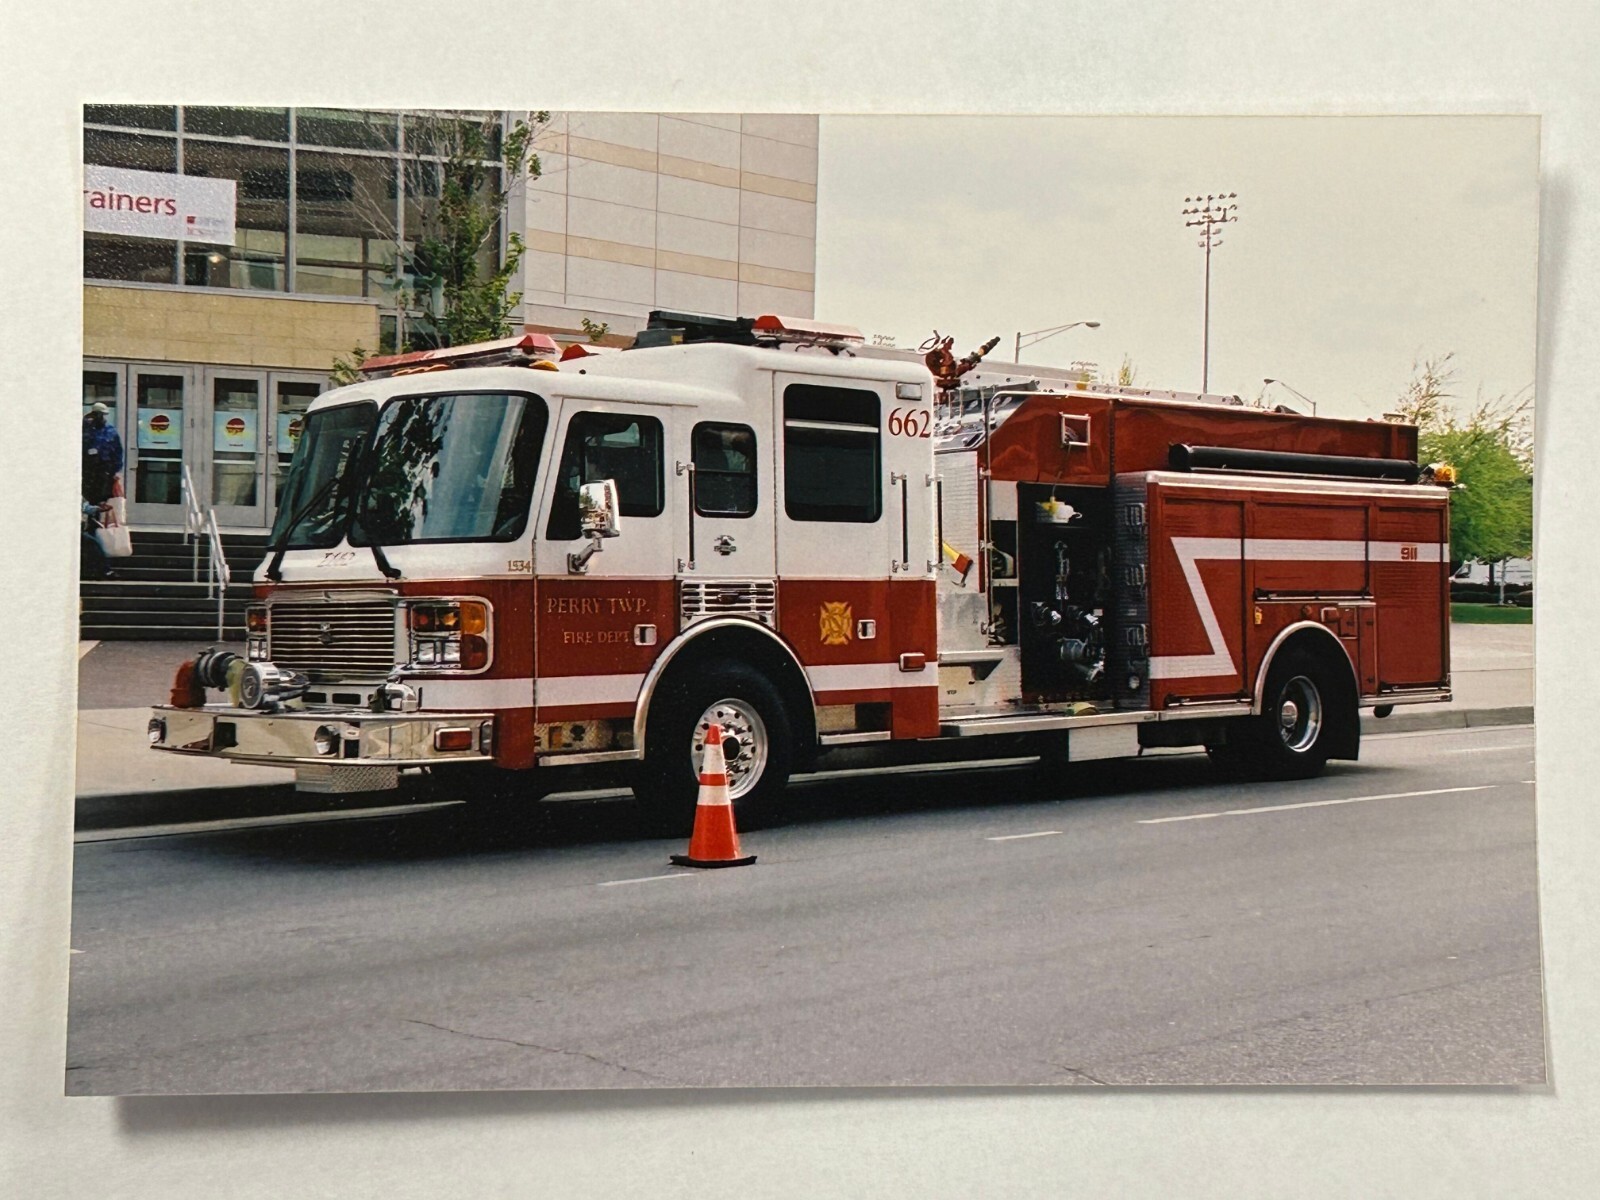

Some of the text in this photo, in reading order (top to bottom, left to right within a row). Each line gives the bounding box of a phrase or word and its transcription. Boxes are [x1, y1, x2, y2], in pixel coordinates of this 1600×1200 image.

[888, 407, 931, 438] 662
[1401, 547, 1418, 560] 911
[507, 560, 531, 573] 1534
[547, 597, 650, 615] PERRY TWP.
[563, 630, 631, 644] FIRE DEPT
